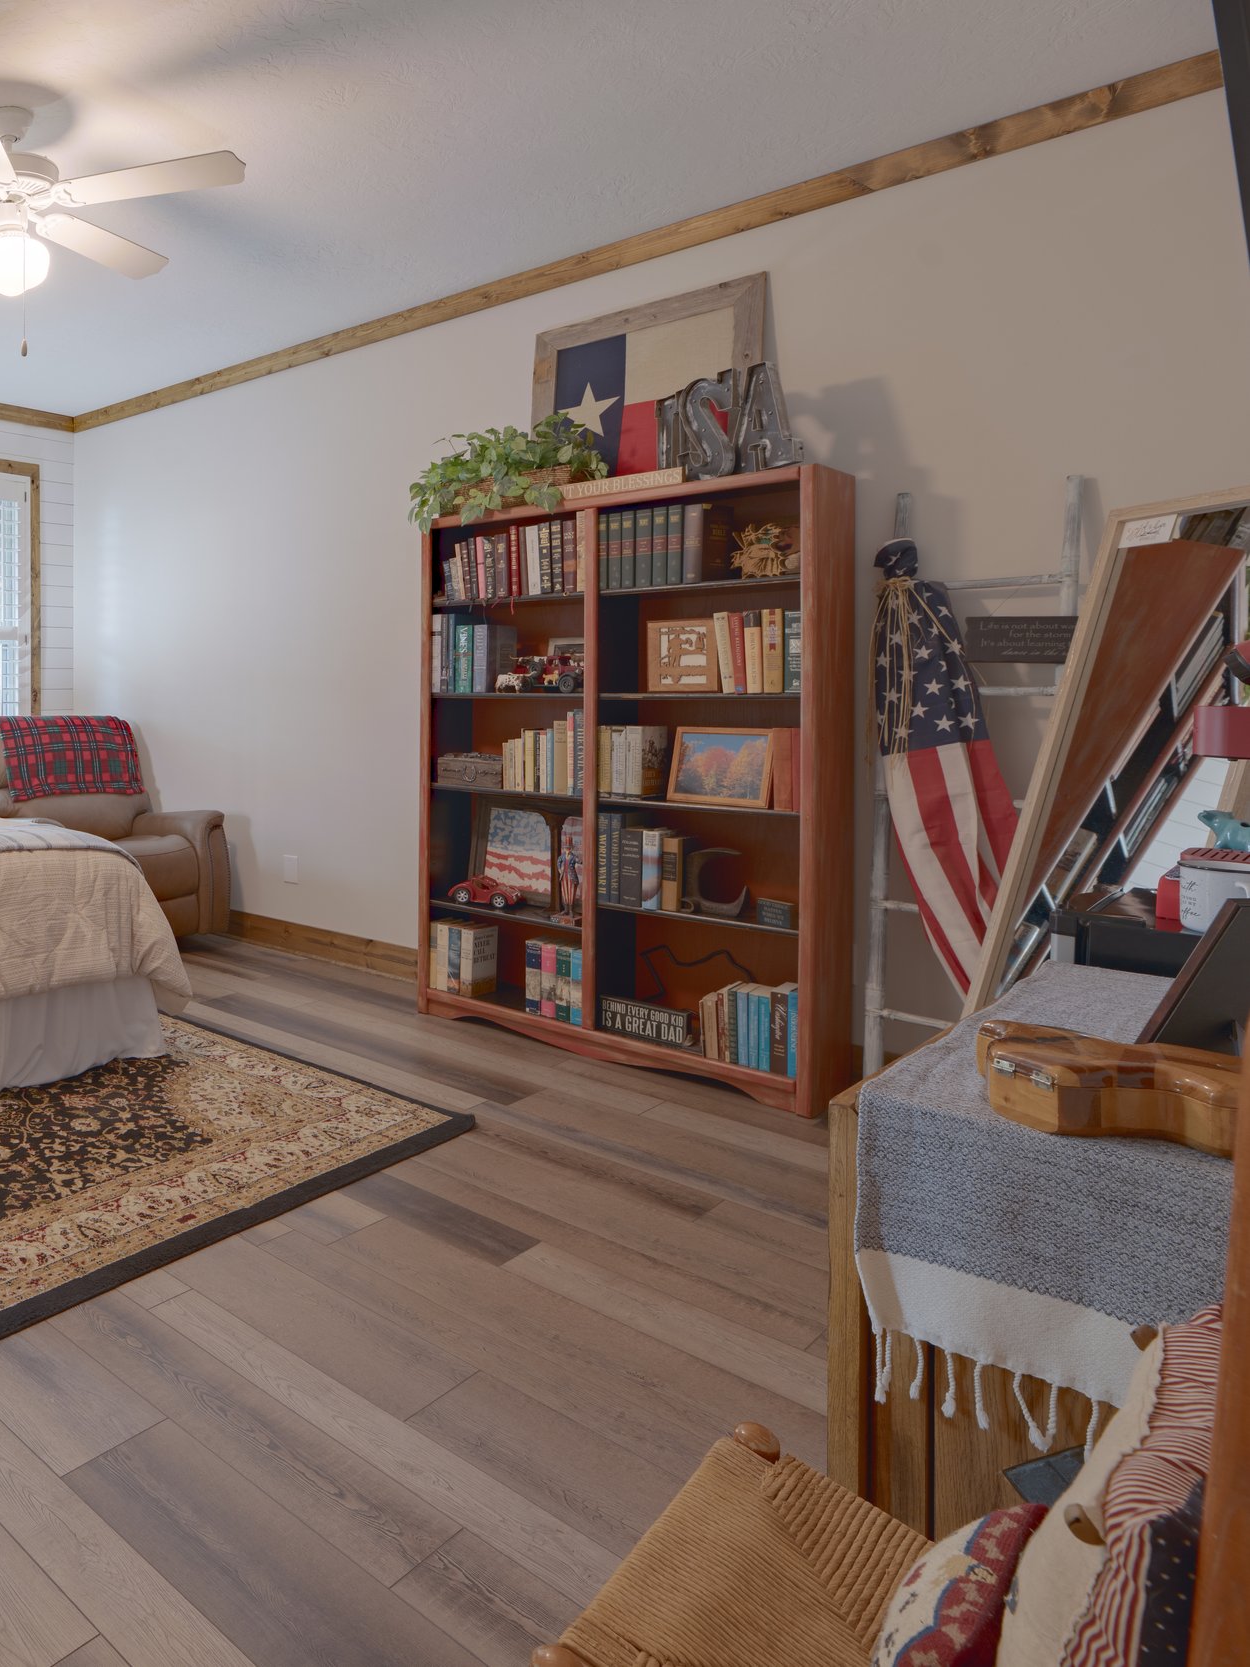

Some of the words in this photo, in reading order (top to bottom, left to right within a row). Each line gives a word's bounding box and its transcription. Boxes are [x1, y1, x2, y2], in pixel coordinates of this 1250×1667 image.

[577, 479, 610, 497] YOUR
[613, 469, 681, 491] BLESSINGS
[1008, 629, 1023, 638] for
[1025, 629, 1043, 638] the
[1011, 622, 1028, 630] not
[1029, 620, 1059, 630] about
[997, 638, 1026, 647] about
[1026, 638, 1065, 649] learning
[576, 746, 585, 769] CIVIL
[576, 770, 585, 790] WAR
[598, 834, 607, 865] WORLD
[611, 831, 620, 866] WORLD
[598, 866, 607, 886] WAR
[610, 869, 619, 889] WAR
[598, 887, 607, 895] II
[473, 952, 496, 964] RETREAT
[602, 999, 626, 1014] BEHIND
[627, 1005, 649, 1018] EVERY
[650, 1010, 669, 1024] GOOD
[670, 1014, 684, 1027] KID
[601, 1010, 612, 1027] IS
[615, 1013, 622, 1030] A
[625, 1016, 658, 1038] GREAT
[661, 1023, 683, 1044] DAD
